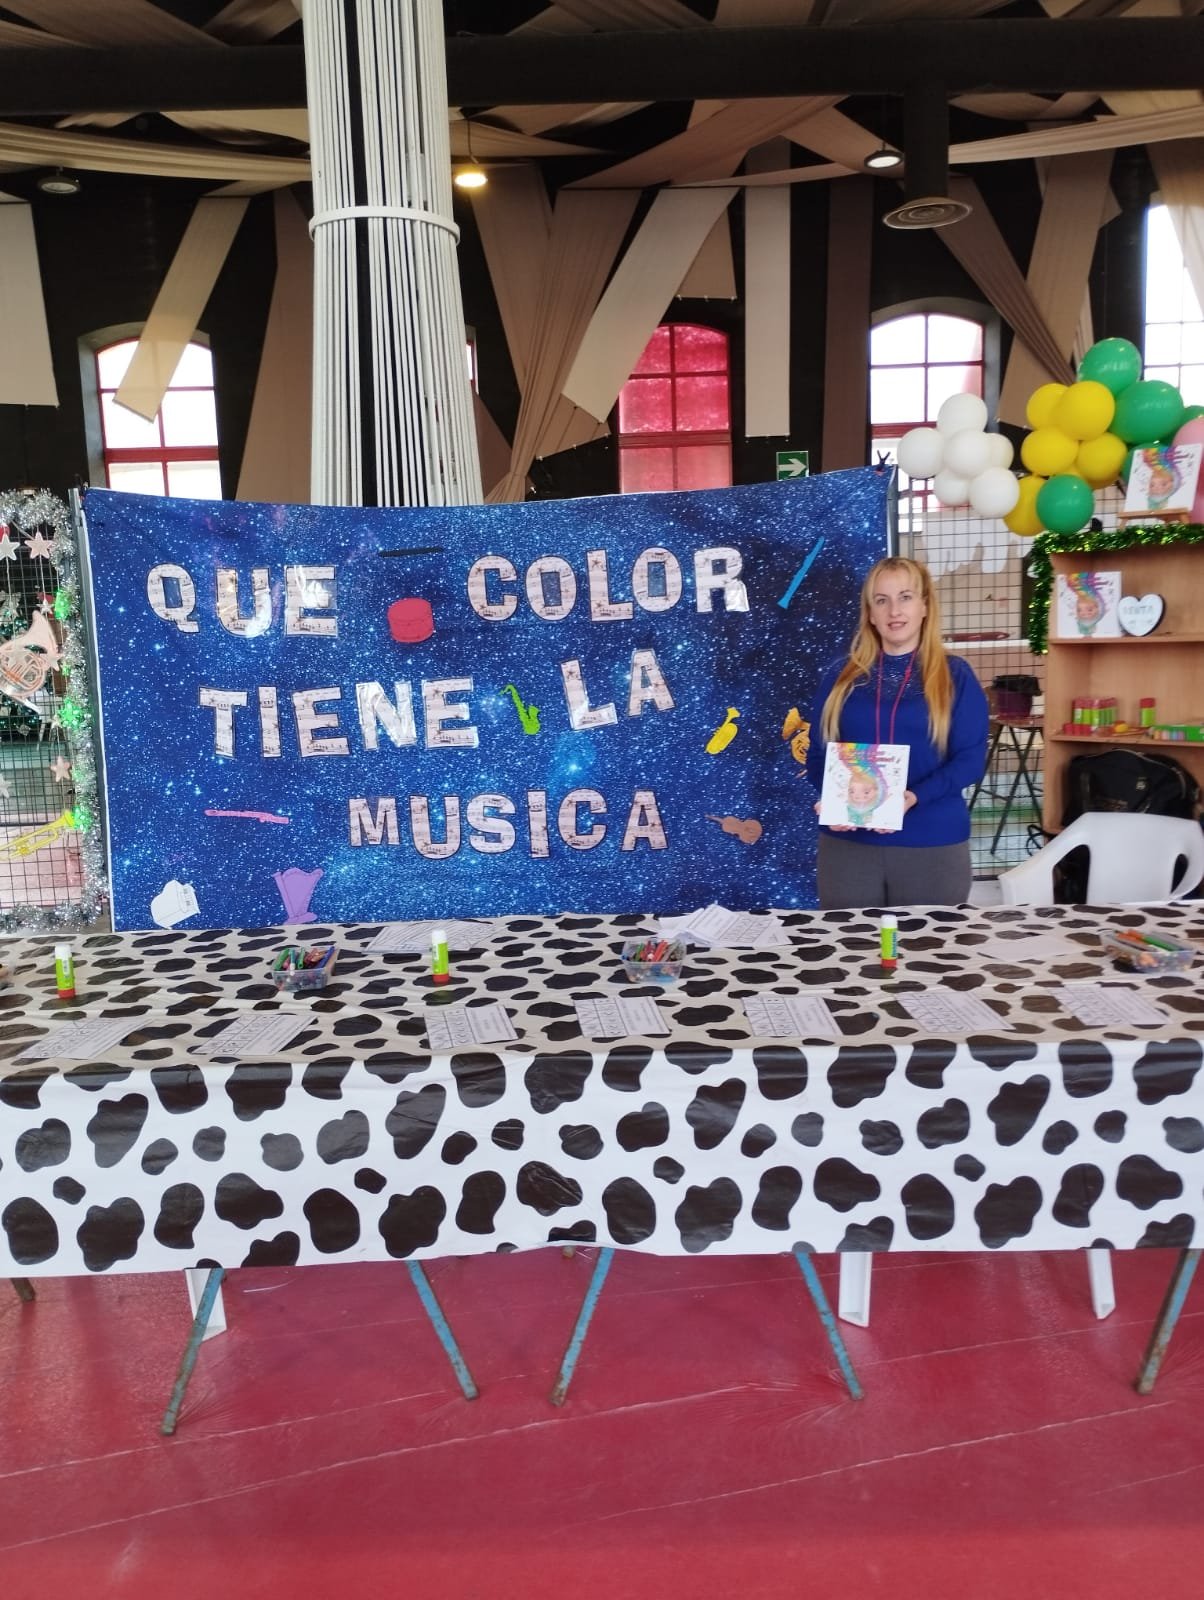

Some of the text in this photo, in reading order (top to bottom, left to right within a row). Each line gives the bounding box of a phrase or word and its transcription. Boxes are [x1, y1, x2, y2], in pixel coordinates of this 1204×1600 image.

[147, 547, 749, 636] QUE COLOR
[198, 649, 675, 758] TIENE LA
[348, 788, 667, 860] MUSICA
